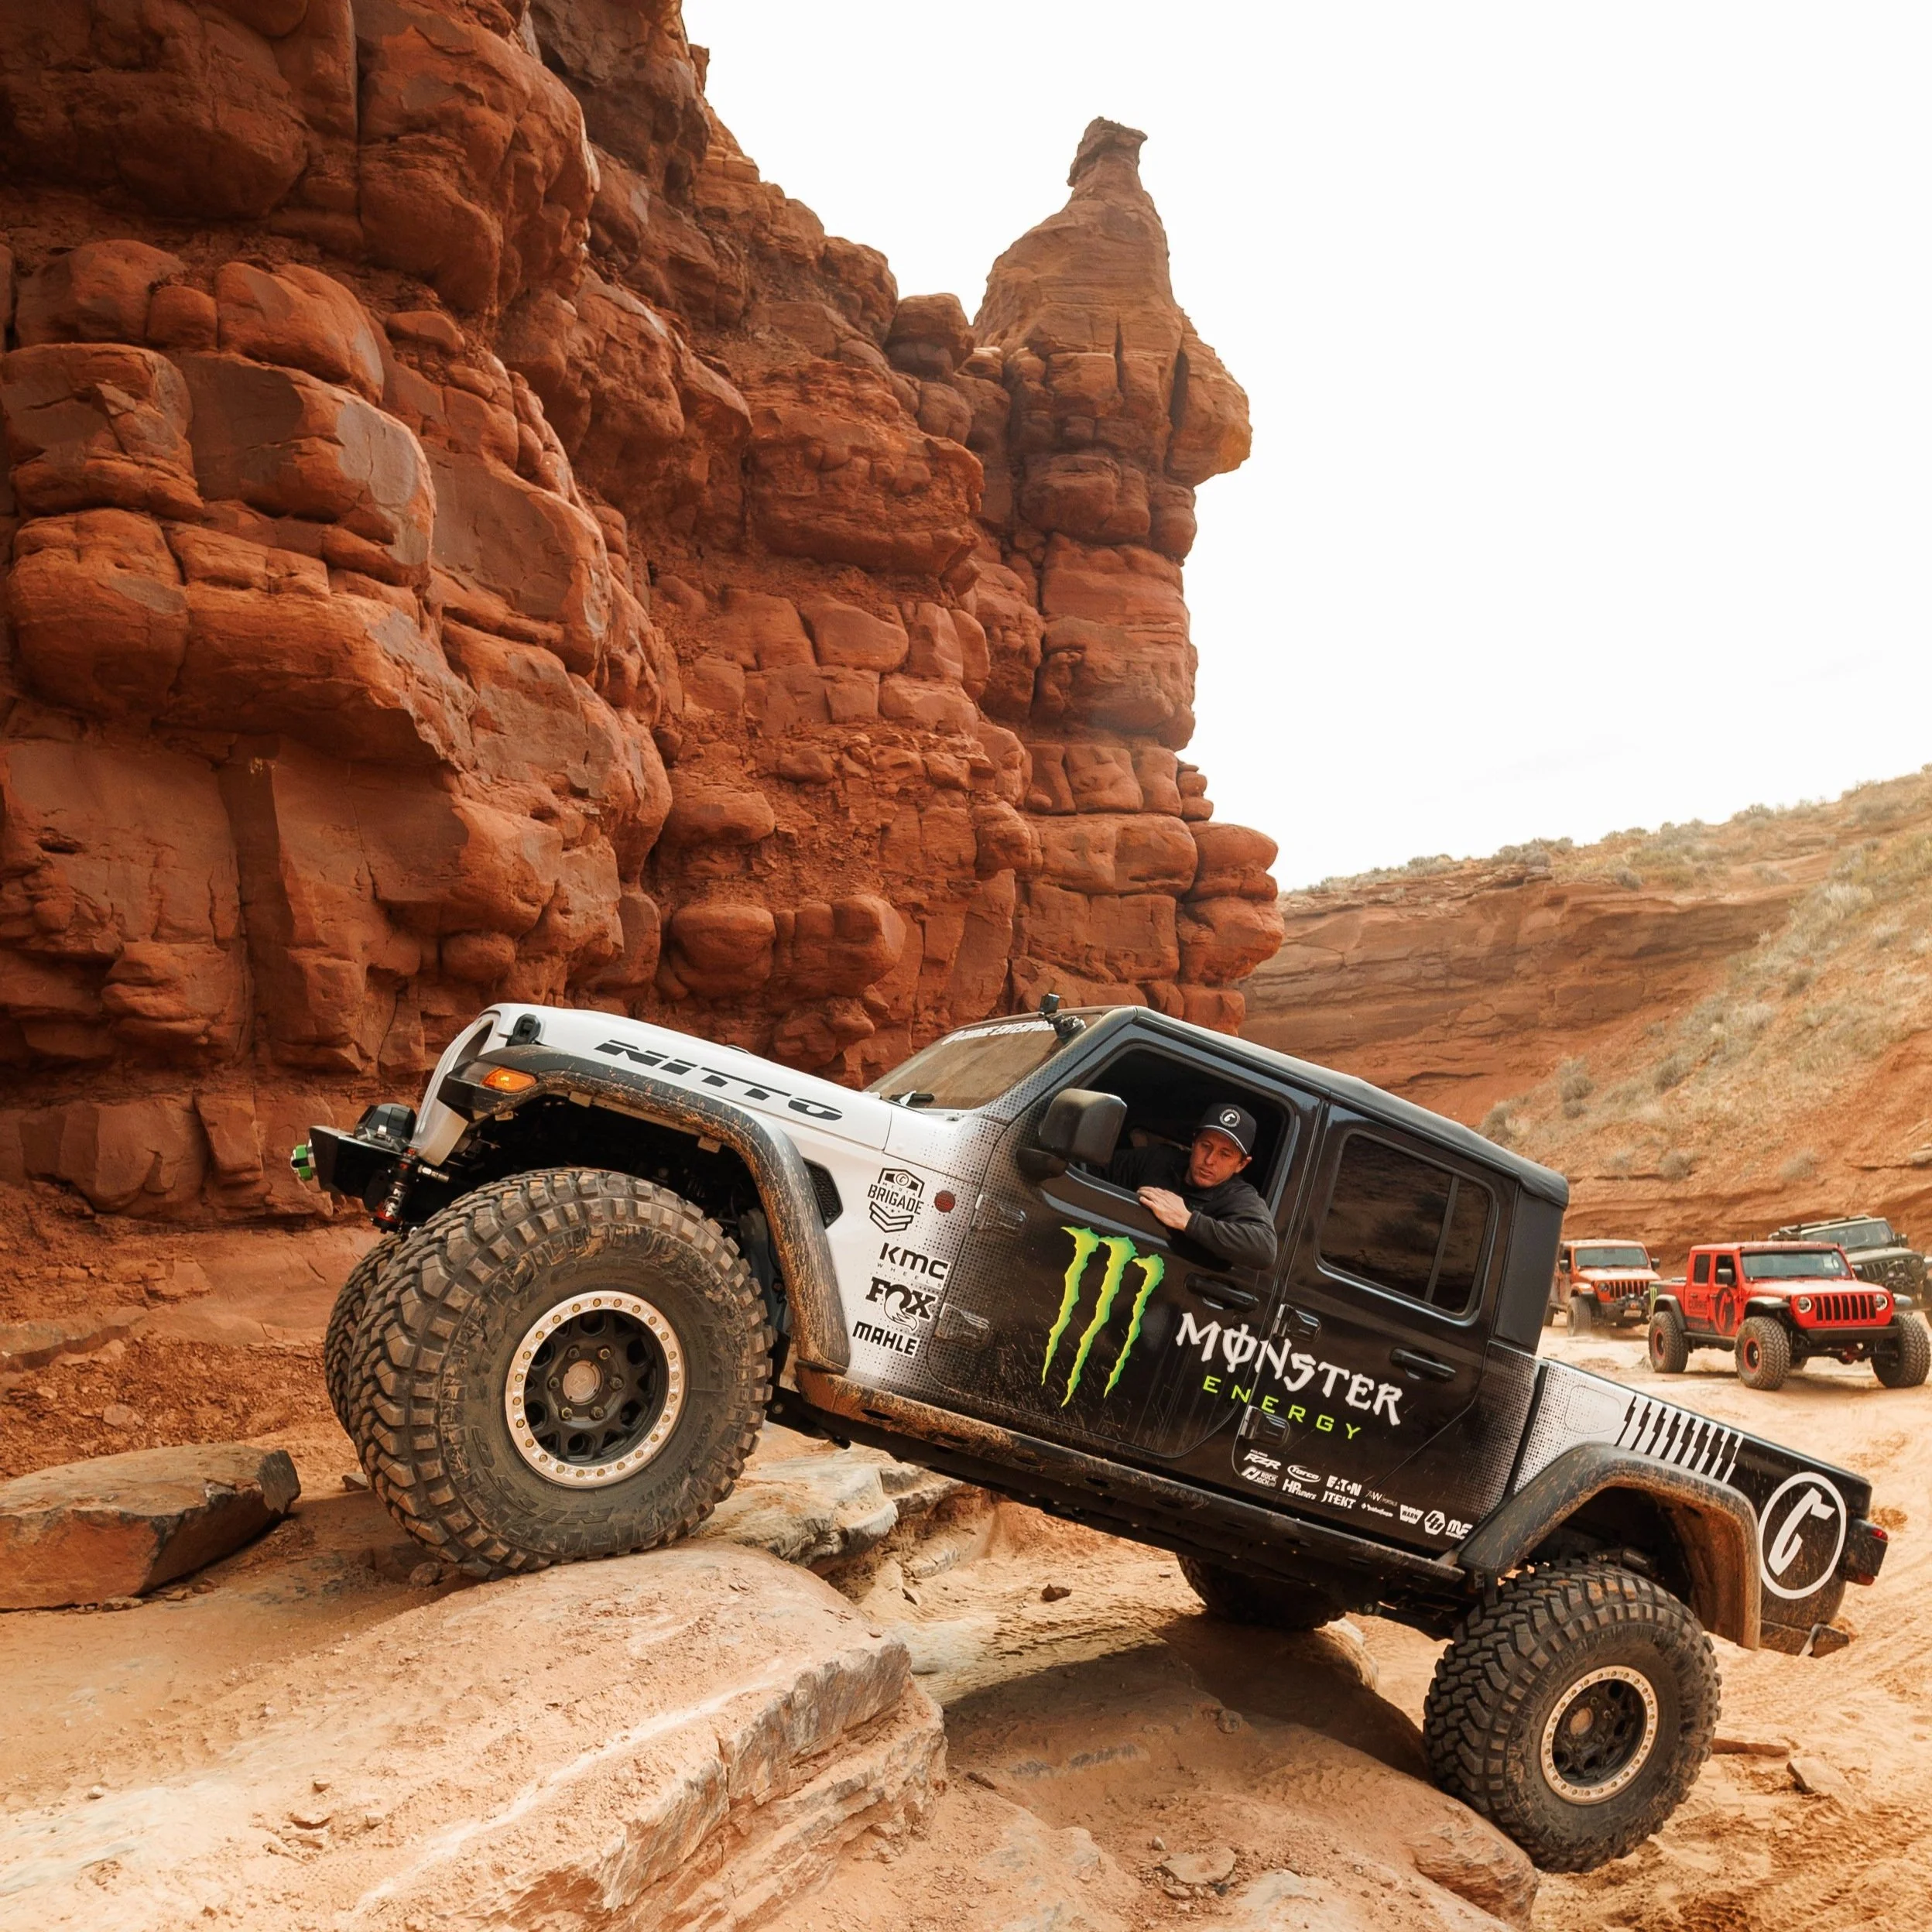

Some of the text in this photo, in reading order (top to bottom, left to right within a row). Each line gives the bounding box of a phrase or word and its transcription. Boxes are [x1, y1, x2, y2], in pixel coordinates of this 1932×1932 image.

[594, 1040, 843, 1121] NITTO
[868, 1184, 924, 1215] BRIGADE
[877, 1262, 942, 1288] WHEELS
[879, 1242, 948, 1280] KMC
[865, 1276, 937, 1324] FOX
[852, 1321, 918, 1356] MAHLE
[1202, 1375, 1361, 1440] ENERGY
[1243, 1452, 1282, 1471] RZR
[1321, 1490, 1357, 1509] JTEKT
[1402, 1510, 1419, 1520] WARN
